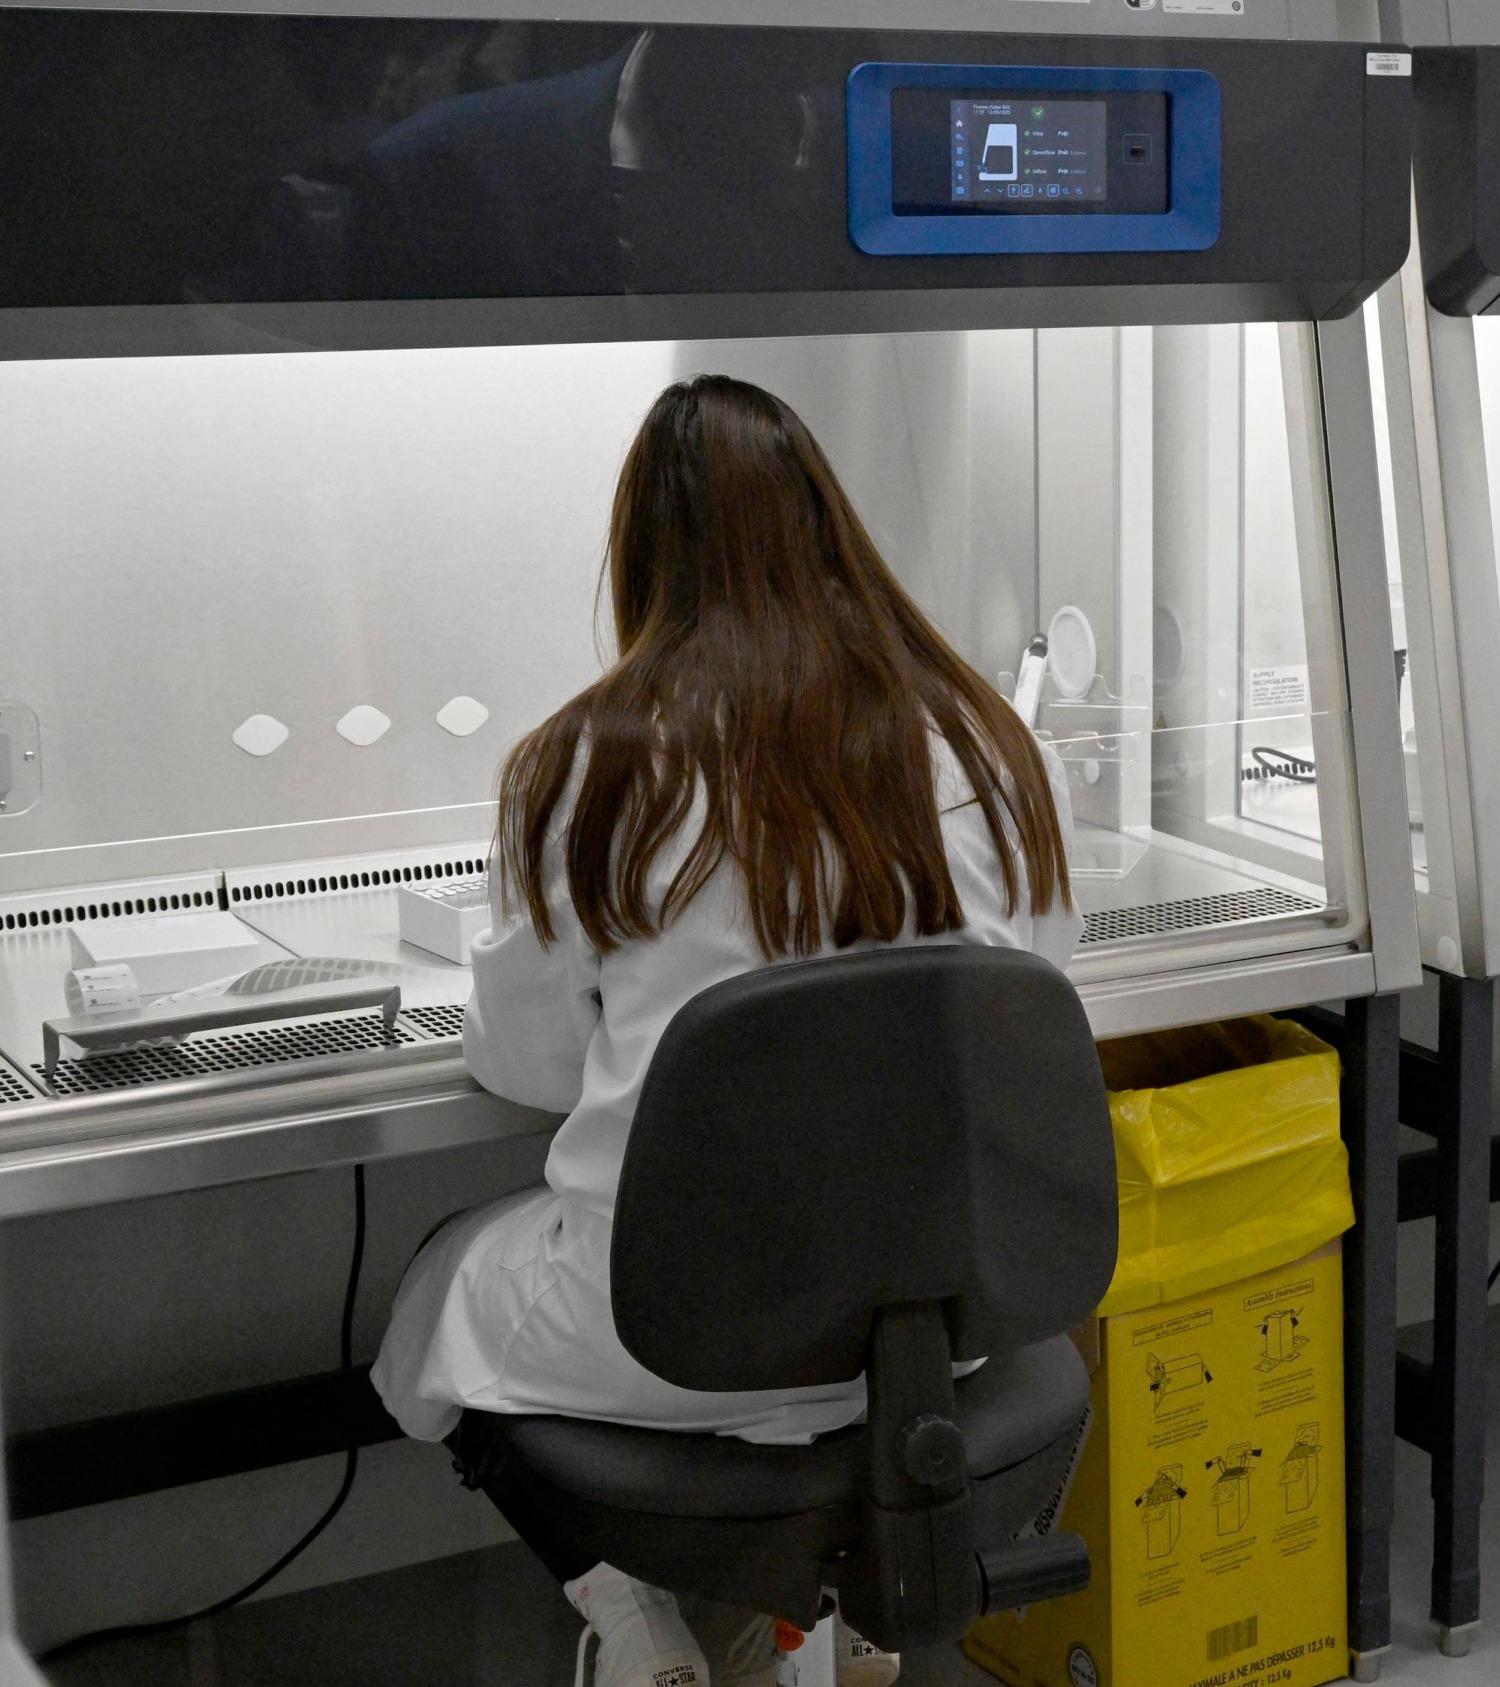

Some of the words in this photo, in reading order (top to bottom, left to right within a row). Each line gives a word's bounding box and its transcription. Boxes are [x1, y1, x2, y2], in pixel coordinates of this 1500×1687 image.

[1237, 1664, 1249, 1678] NE
[1249, 1658, 1266, 1674] PAS
[1324, 1636, 1336, 1649] Kg
[678, 1671, 696, 1685] STAR
